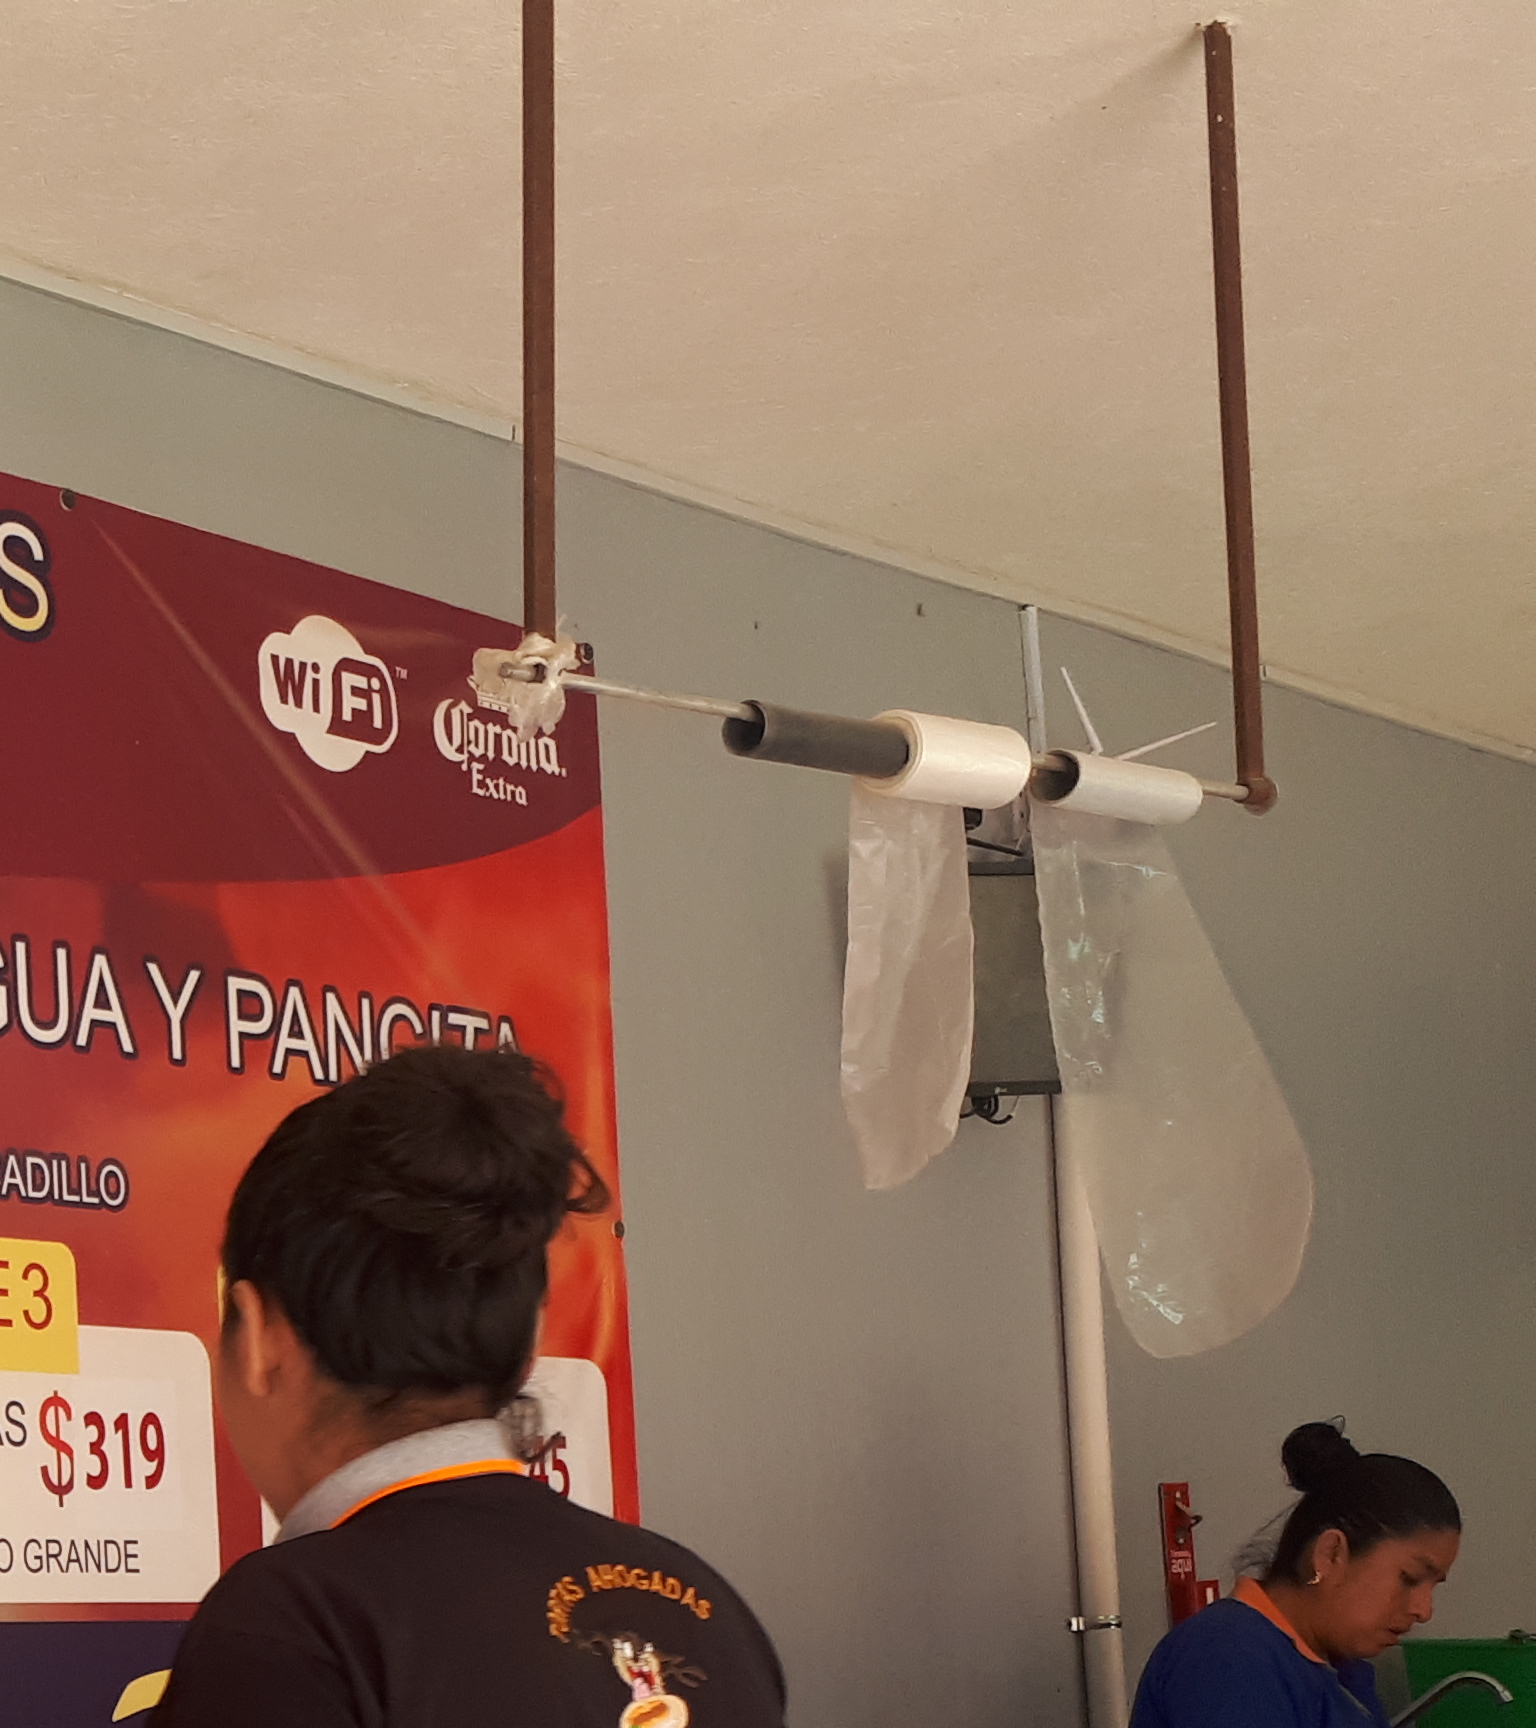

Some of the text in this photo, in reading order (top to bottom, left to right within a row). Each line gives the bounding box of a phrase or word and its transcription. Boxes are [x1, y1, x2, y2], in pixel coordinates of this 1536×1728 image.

[470, 761, 529, 807] Extra
[145, 962, 201, 1060] Y
[21, 1262, 54, 1330] 3
[38, 1390, 166, 1507] $319
[24, 1538, 141, 1574] GRANDE
